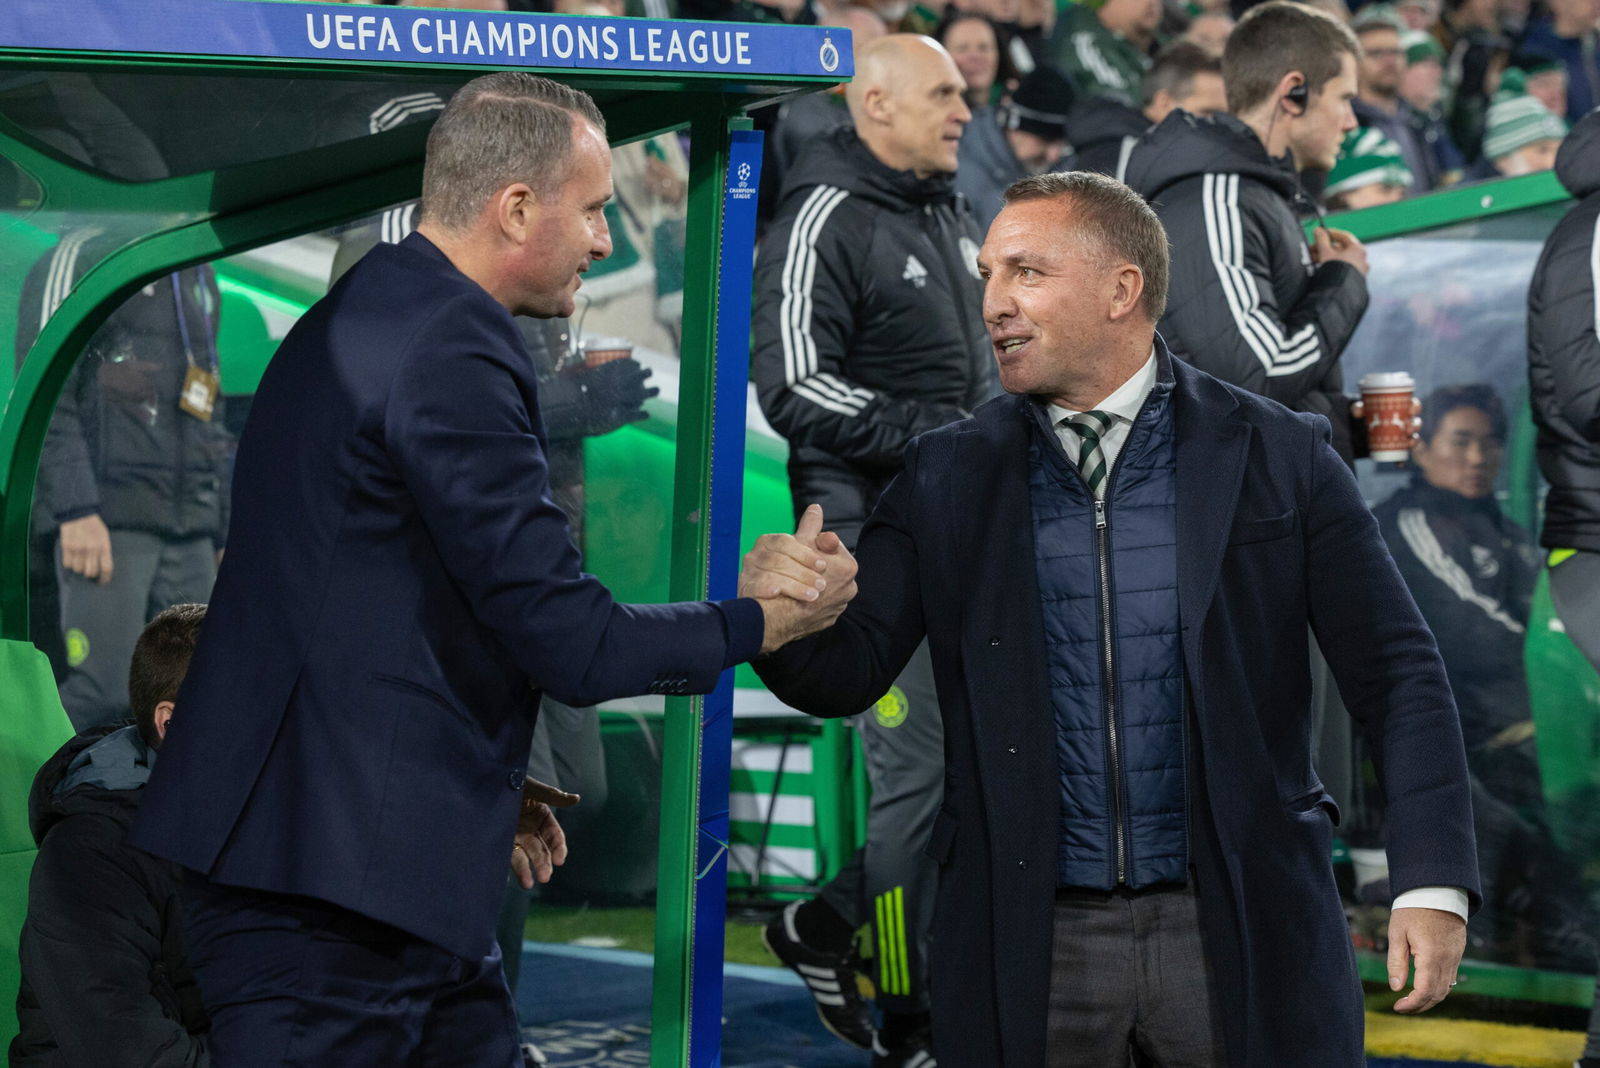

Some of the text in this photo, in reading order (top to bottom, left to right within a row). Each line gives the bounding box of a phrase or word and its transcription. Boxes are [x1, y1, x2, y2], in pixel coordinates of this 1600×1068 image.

[306, 13, 752, 65] UEFA CHAMPIONS LEAGUE
